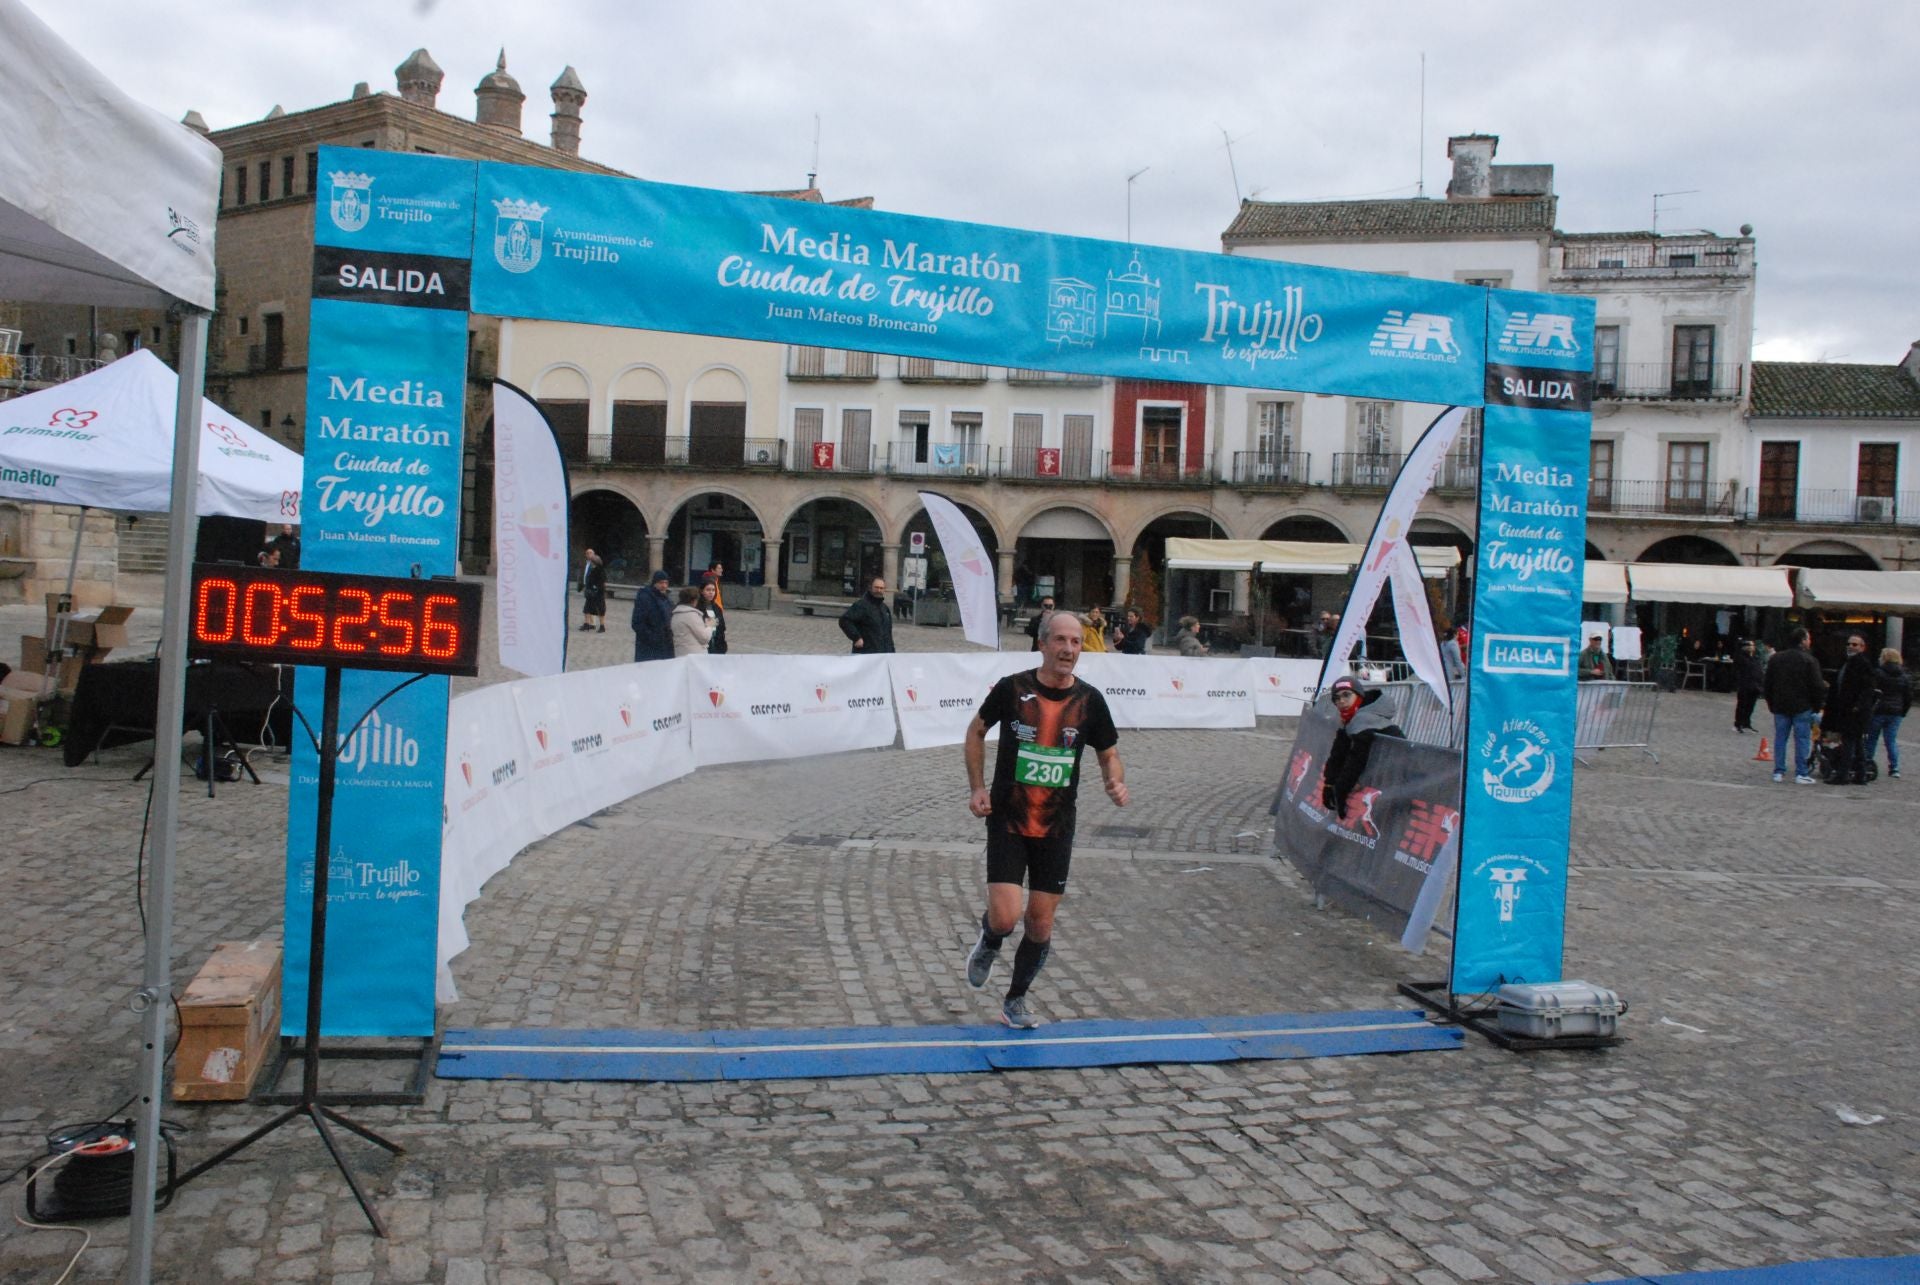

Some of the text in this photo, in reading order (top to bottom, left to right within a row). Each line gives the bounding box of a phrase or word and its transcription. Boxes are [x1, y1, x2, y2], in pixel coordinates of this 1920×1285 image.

[379, 194, 461, 210] Ayuntamiento de
[377, 206, 433, 225] Trujillo
[553, 226, 654, 249] Ayuntamiento de
[551, 241, 620, 265] Trujillo
[759, 222, 1022, 284] Media Maratón
[338, 264, 446, 295] SALIDA
[717, 254, 995, 323] Ciudad de Trujillo
[766, 302, 938, 335] Juan Mateos Broncano
[1194, 281, 1324, 353] Trujillo
[1222, 338, 1238, 360] te
[1370, 347, 1458, 364] www.musicrun.es
[1498, 343, 1576, 359] www.musicrun.es
[327, 375, 445, 408] Media
[1502, 376, 1576, 401] SALIDA
[3, 426, 99, 441] primaflor
[318, 415, 452, 447] Maratón
[333, 451, 431, 476] Ciudad de
[1495, 462, 1574, 488] Media
[315, 474, 445, 528] Trujillo
[1489, 493, 1579, 518] Maratón
[320, 529, 441, 546] Juan Mateos Broncano
[1498, 521, 1564, 541] Ciudad de
[1486, 540, 1575, 581] Trujillo
[196, 578, 458, 658] 00:52:56
[1495, 645, 1557, 665] HABLA
[1480, 717, 1551, 758] Club Atletismo
[1024, 761, 1064, 785] 230
[1486, 782, 1539, 800] TRUJILLO
[356, 859, 420, 889] Trujillo
[376, 886, 386, 900] te
